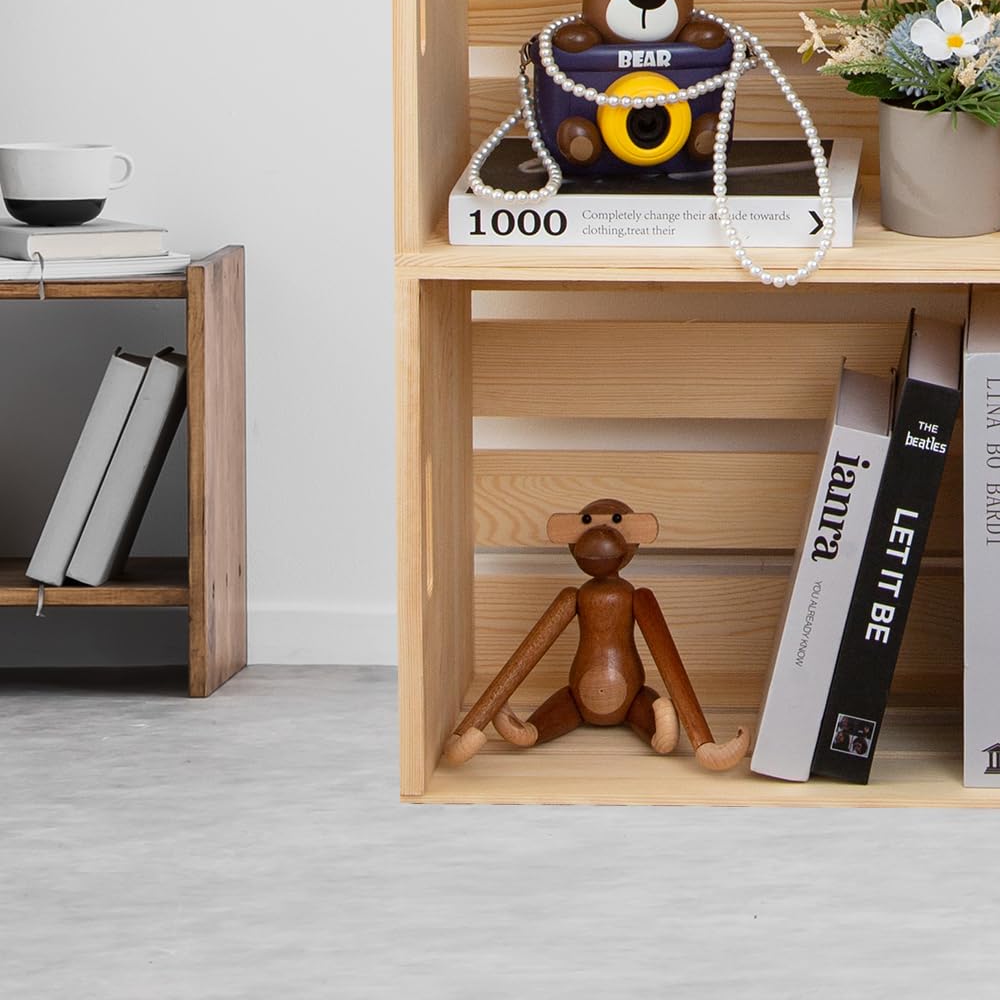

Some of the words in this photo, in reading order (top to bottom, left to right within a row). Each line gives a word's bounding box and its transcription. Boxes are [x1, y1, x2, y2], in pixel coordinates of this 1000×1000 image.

[618, 50, 672, 68] BEAR
[468, 209, 568, 236] 1000
[582, 210, 642, 222] Completely
[644, 210, 680, 223] change
[683, 209, 706, 221] their
[708, 210, 748, 221] atude
[750, 210, 791, 221] towards
[652, 224, 676, 236] their
[918, 421, 939, 434] THE
[905, 431, 947, 454] beatles
[811, 450, 871, 563] ianra
[885, 507, 919, 566] LET
[811, 580, 823, 600] YOU
[877, 568, 904, 598] IT
[802, 599, 818, 639] ALREADY
[865, 602, 896, 644] BE
[795, 638, 808, 667] KNOW
